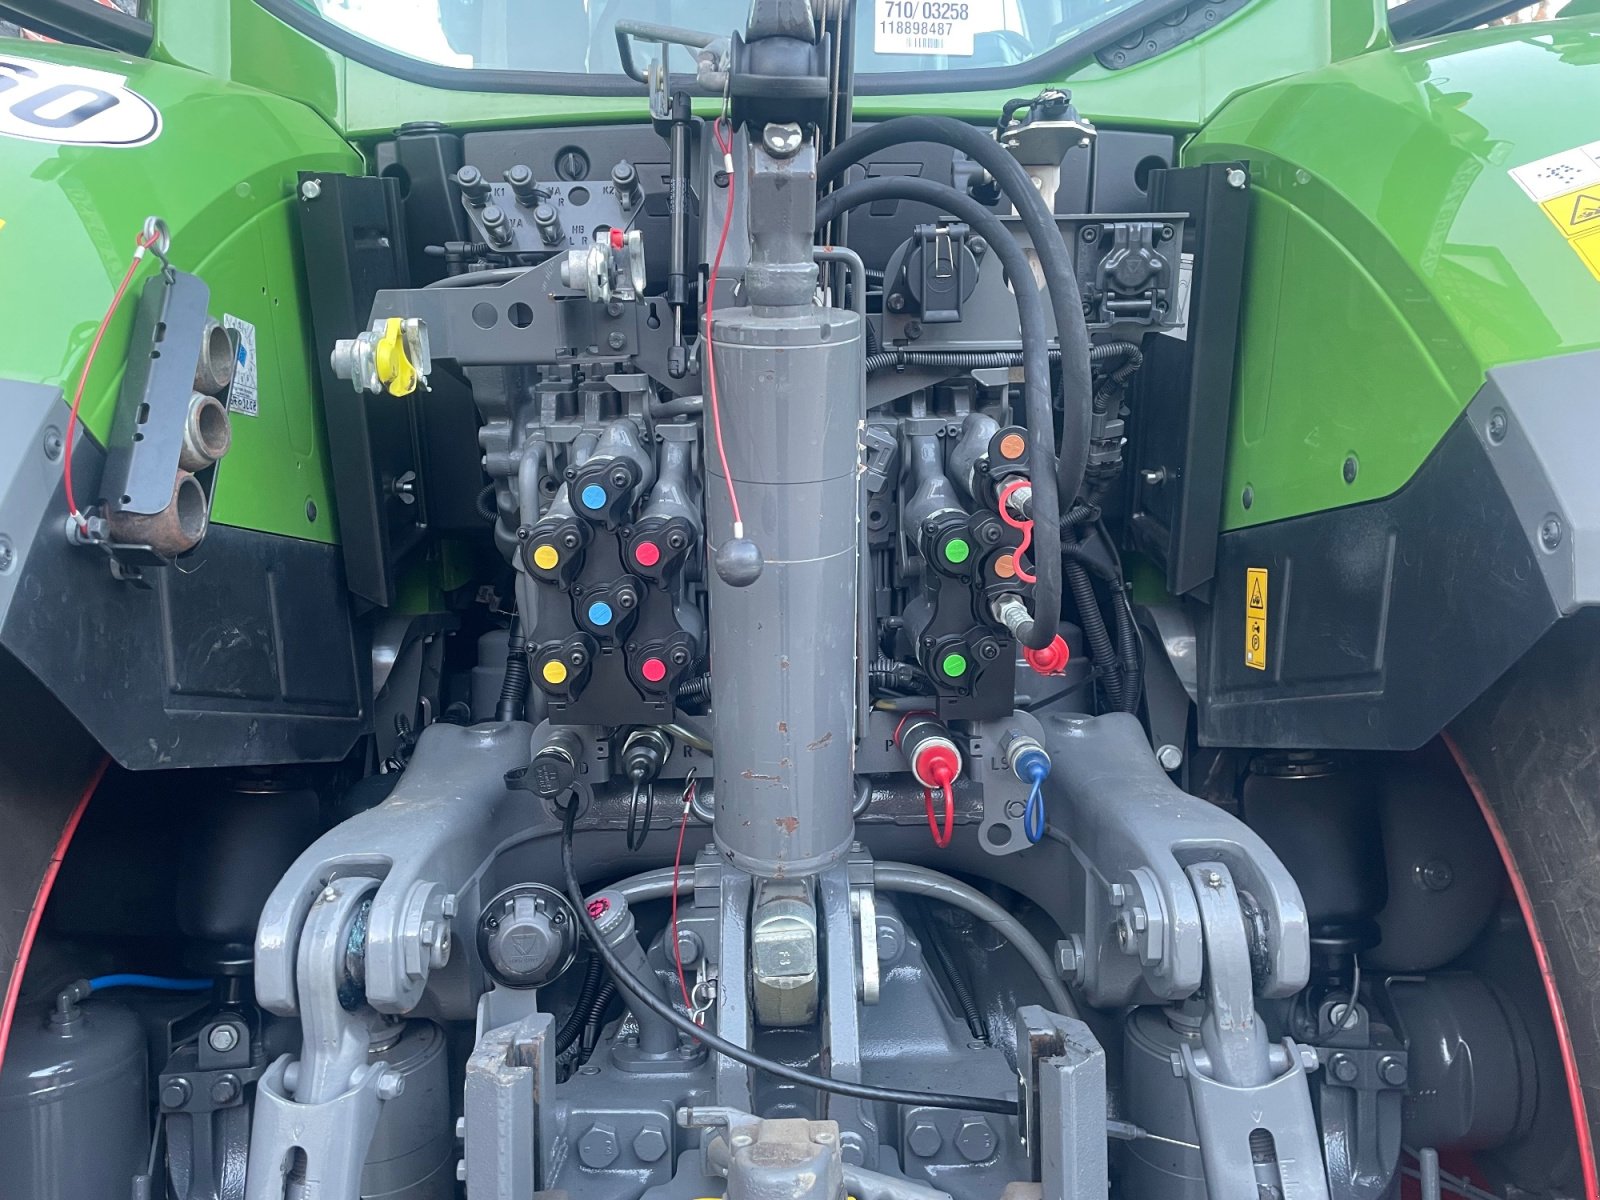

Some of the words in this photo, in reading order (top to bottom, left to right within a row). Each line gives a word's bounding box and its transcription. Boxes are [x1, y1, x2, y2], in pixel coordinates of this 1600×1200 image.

[880, 21, 953, 36] 118898487
[494, 187, 505, 197] K1
[602, 186, 615, 195] K2
[558, 197, 565, 206] R
[571, 224, 585, 234] HB
[569, 236, 575, 246] L
[581, 236, 588, 245] R
[885, 739, 894, 752] P
[683, 744, 693, 758] R
[991, 756, 1009, 771] LS
